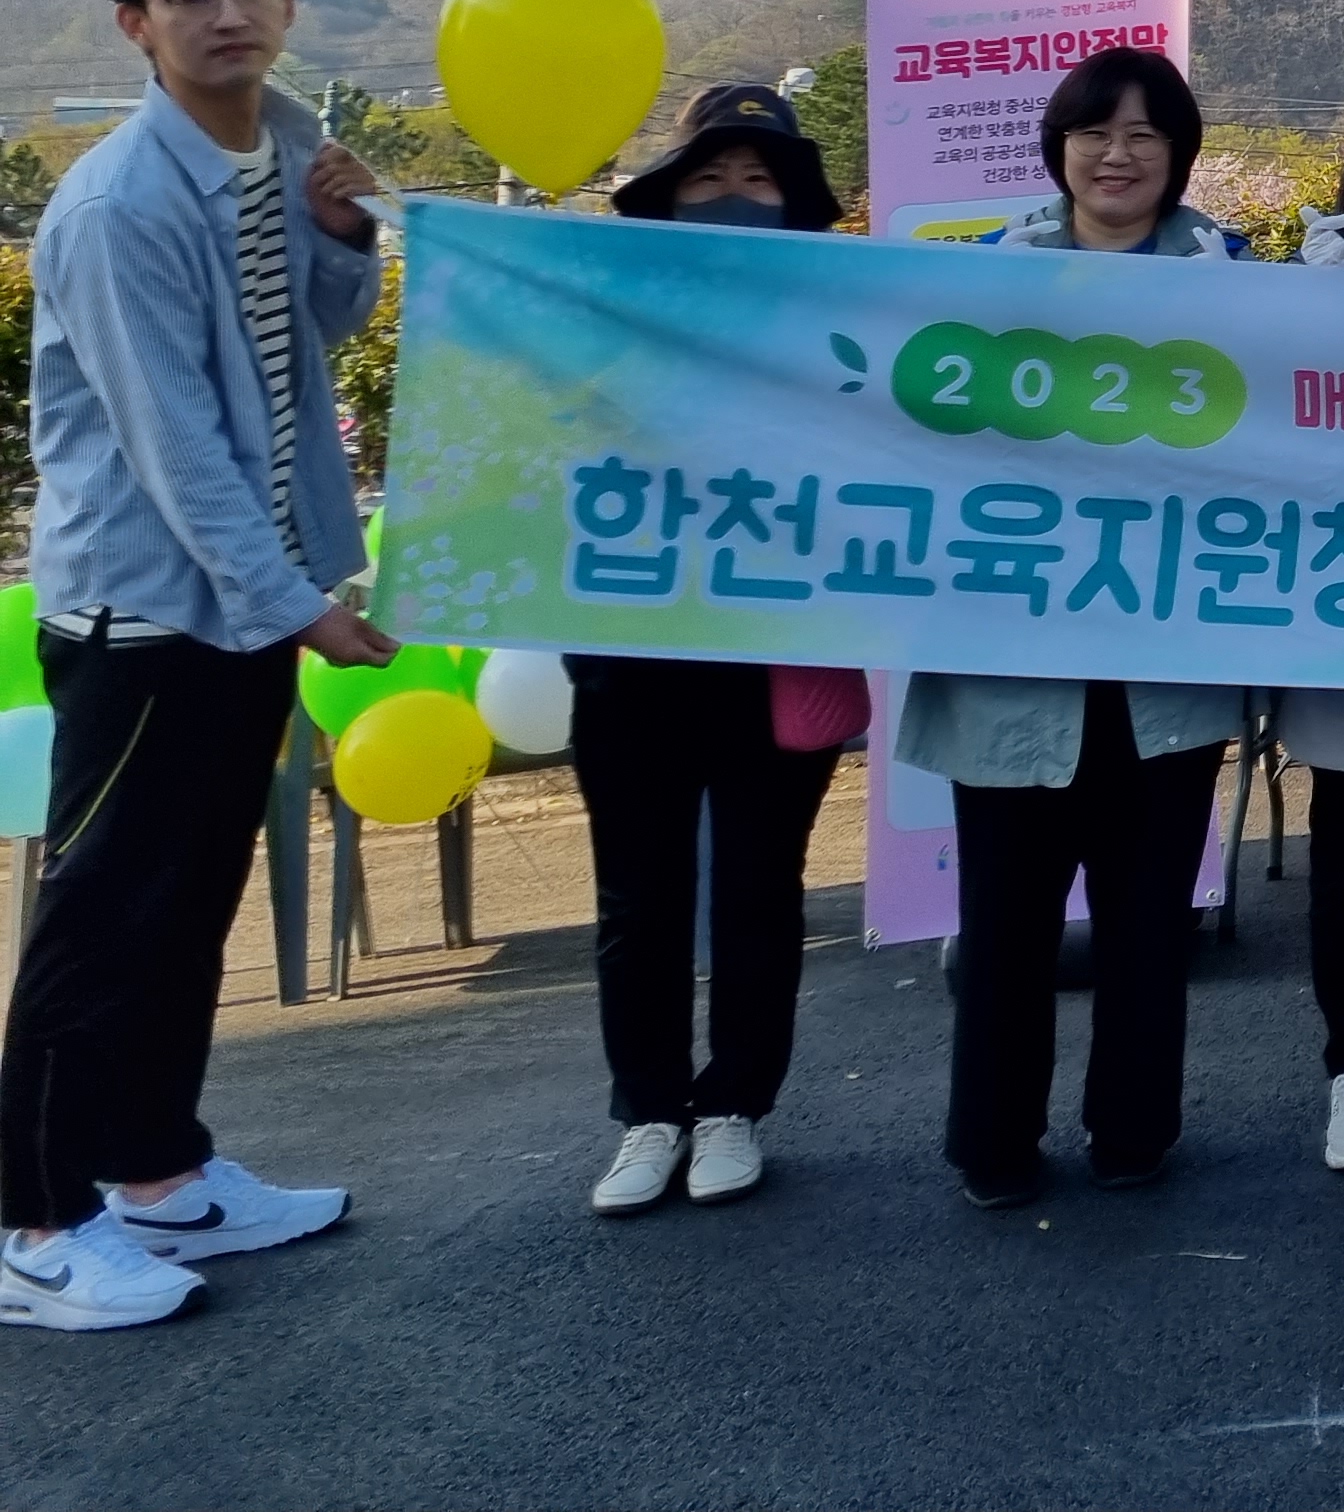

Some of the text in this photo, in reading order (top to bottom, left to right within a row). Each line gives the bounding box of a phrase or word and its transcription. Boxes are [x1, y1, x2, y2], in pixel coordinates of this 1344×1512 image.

[1095, 0, 1137, 14] 교육복지
[926, 95, 1048, 120] 교육지원청 중심으
[937, 124, 983, 143] 연계한
[986, 119, 1031, 138] 맞춤형
[932, 140, 1042, 165] 교육의 공공성을
[982, 164, 1046, 184] 건강한 성
[931, 354, 1206, 416] 2023
